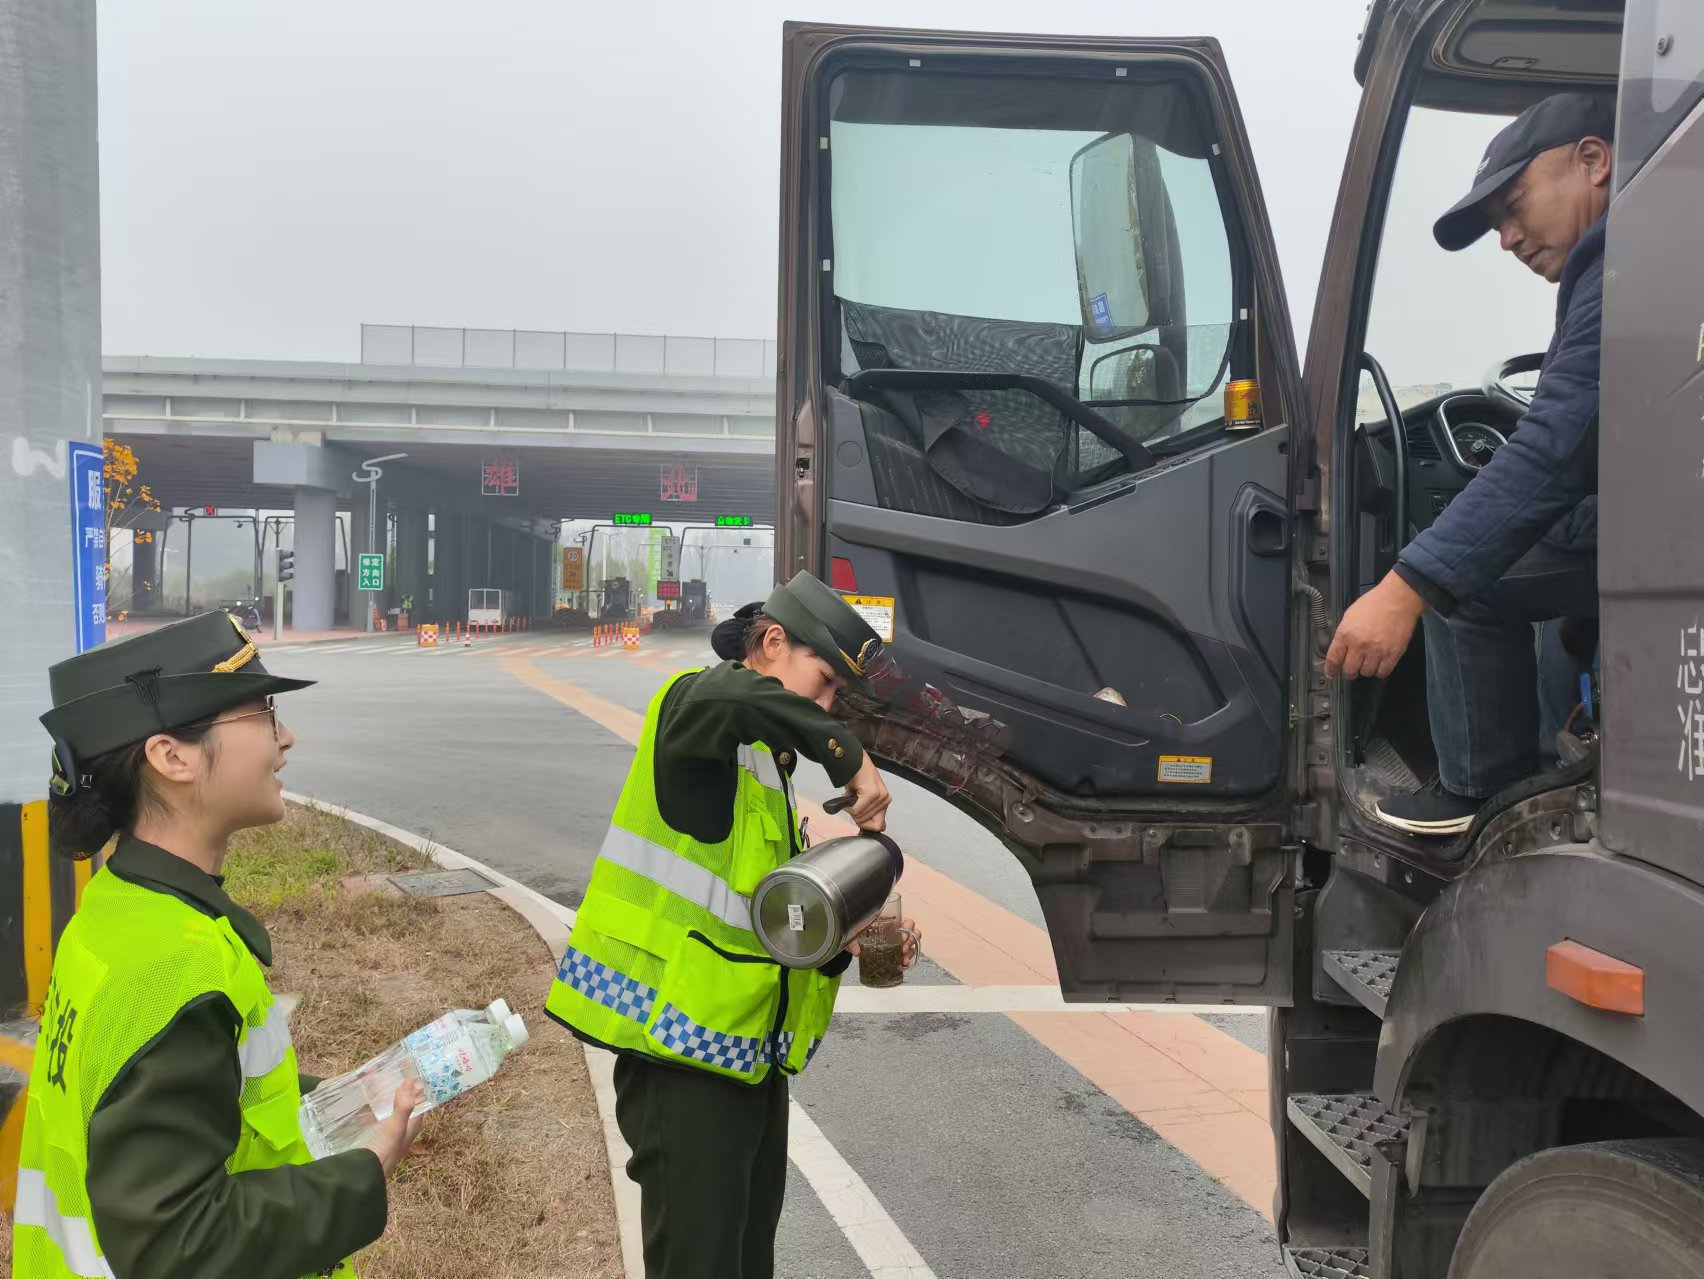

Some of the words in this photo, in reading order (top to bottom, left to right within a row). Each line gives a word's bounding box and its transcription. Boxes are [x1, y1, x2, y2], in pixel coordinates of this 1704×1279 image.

[87, 469, 103, 511] 服
[362, 569, 380, 577] 方向
[362, 578, 380, 586] 入口
